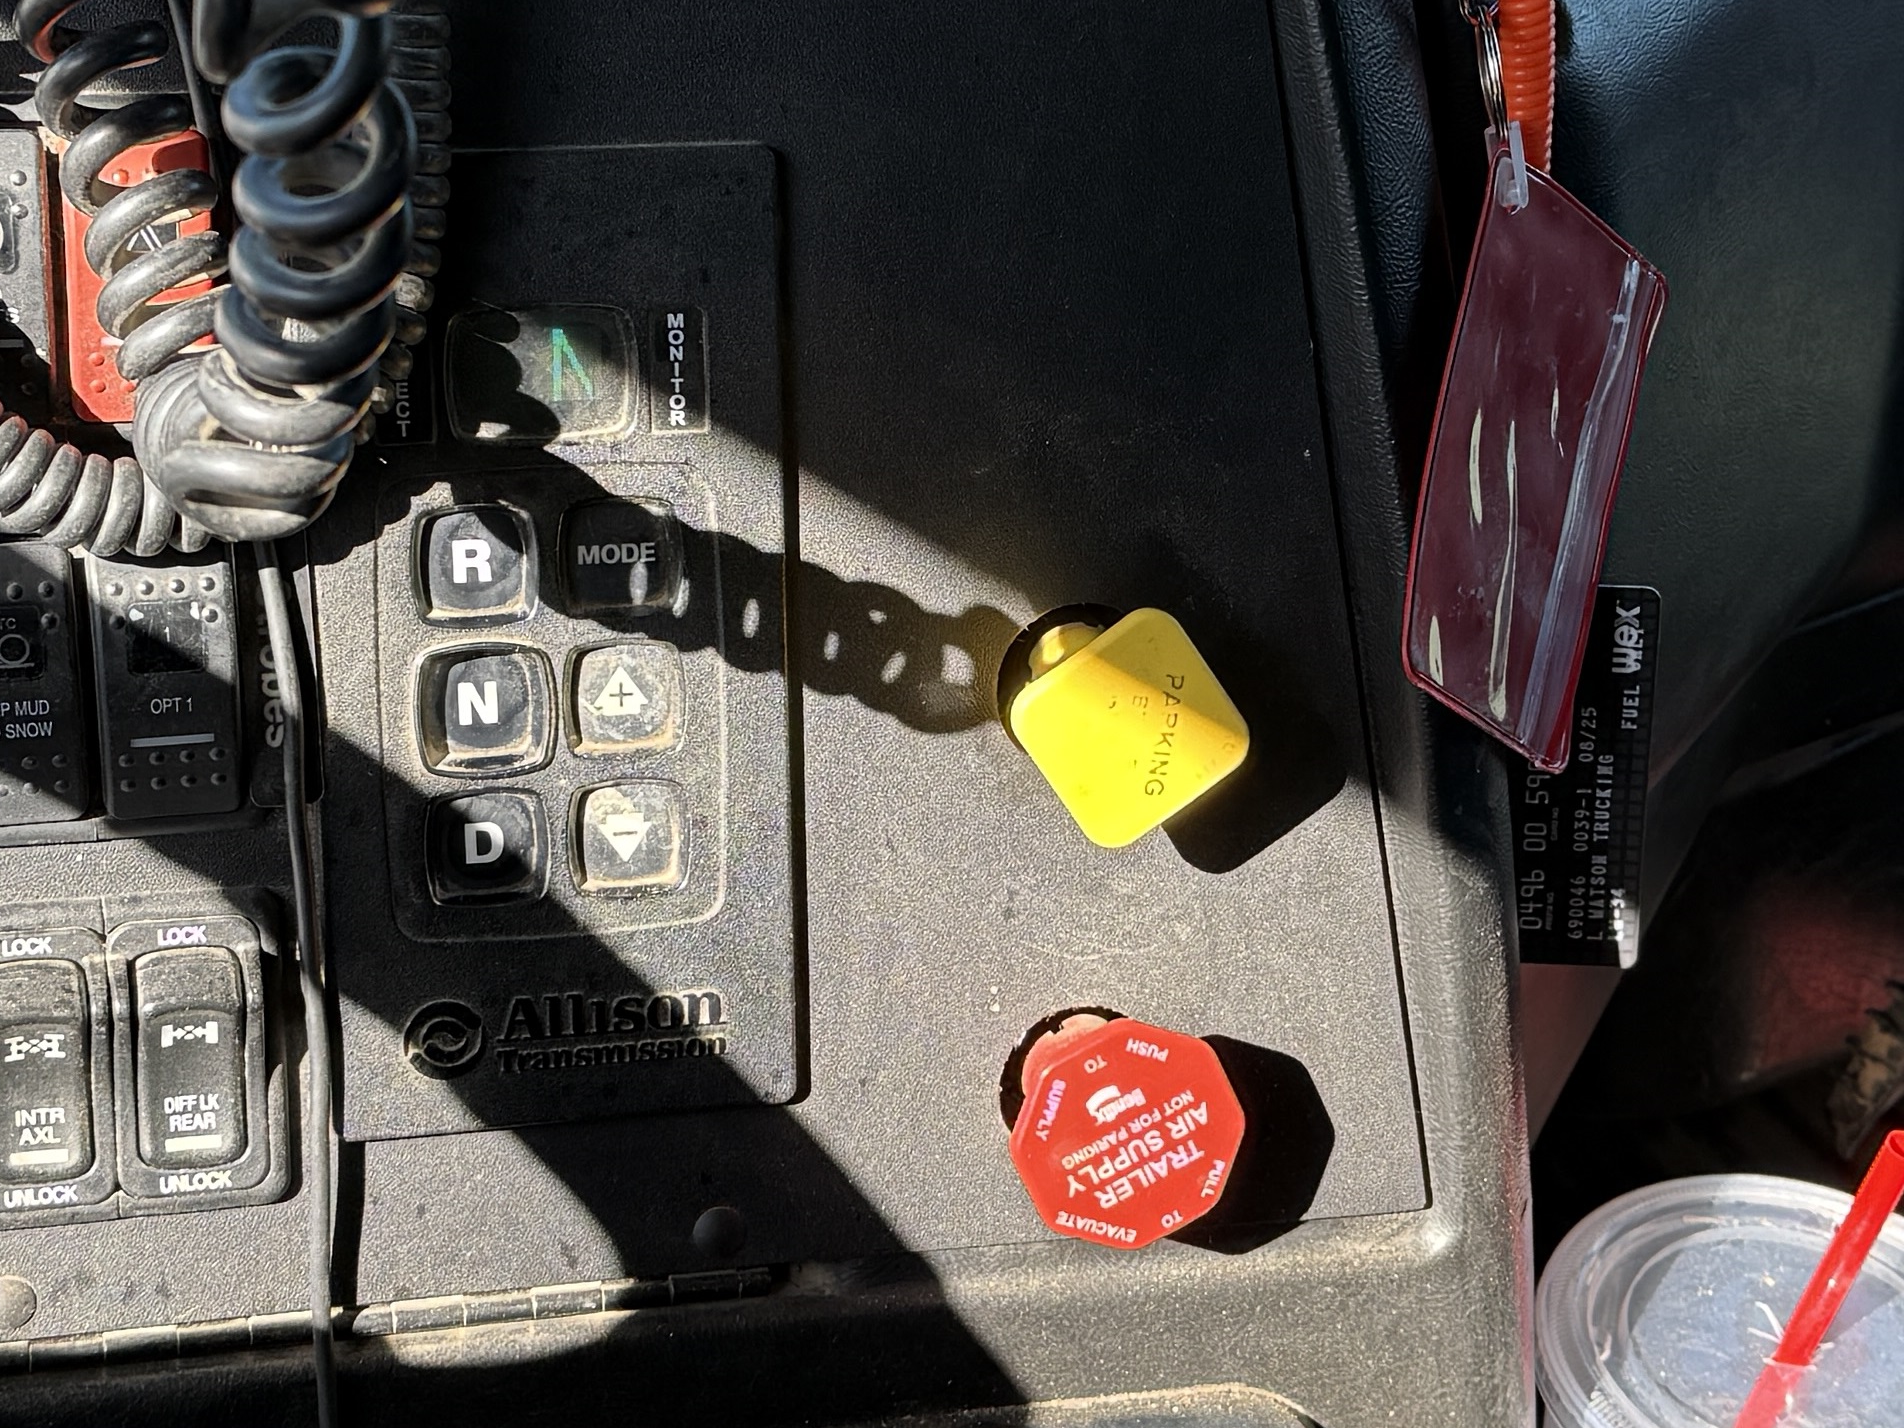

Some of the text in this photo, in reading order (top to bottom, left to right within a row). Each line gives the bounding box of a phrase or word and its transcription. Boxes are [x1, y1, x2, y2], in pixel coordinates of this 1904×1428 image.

[667, 313, 686, 427] MONITOR
[451, 538, 492, 584] R
[577, 542, 656, 565] MODE
[15, 699, 50, 717] MUD
[150, 698, 182, 715] OPT
[457, 680, 499, 726] N
[1620, 683, 1641, 730] FUEL
[5, 721, 54, 739] SNOW
[1589, 752, 1618, 842] TRUCKING
[1522, 819, 1548, 854] 00
[1563, 705, 1598, 939] 690046 0039-1 08/25
[464, 821, 504, 864] D
[1516, 865, 1547, 932] 0496
[1585, 853, 1611, 921] WATSON
[1, 936, 53, 957] LOCK
[157, 925, 207, 945] LOCK
[502, 990, 723, 1039] Allison
[498, 1035, 728, 1073] Transmission
[164, 1093, 220, 1114] DIFF LK
[1035, 1037, 1169, 1142] PUSH TO SUPPLY
[1095, 1087, 1146, 1125] Bendix
[15, 1107, 66, 1127] INTR
[19, 1127, 61, 1145] AXL
[169, 1112, 216, 1132] REAR
[1061, 1090, 1195, 1170] NOT FOR PARKING
[1066, 1101, 1209, 1198] AIR SUPPLY
[159, 1171, 233, 1194] UNLOCK
[1093, 1139, 1205, 1210] TRAILER
[3, 1185, 79, 1208] UNLOCK
[1055, 1159, 1226, 1243] PULL TO EVACUATE
